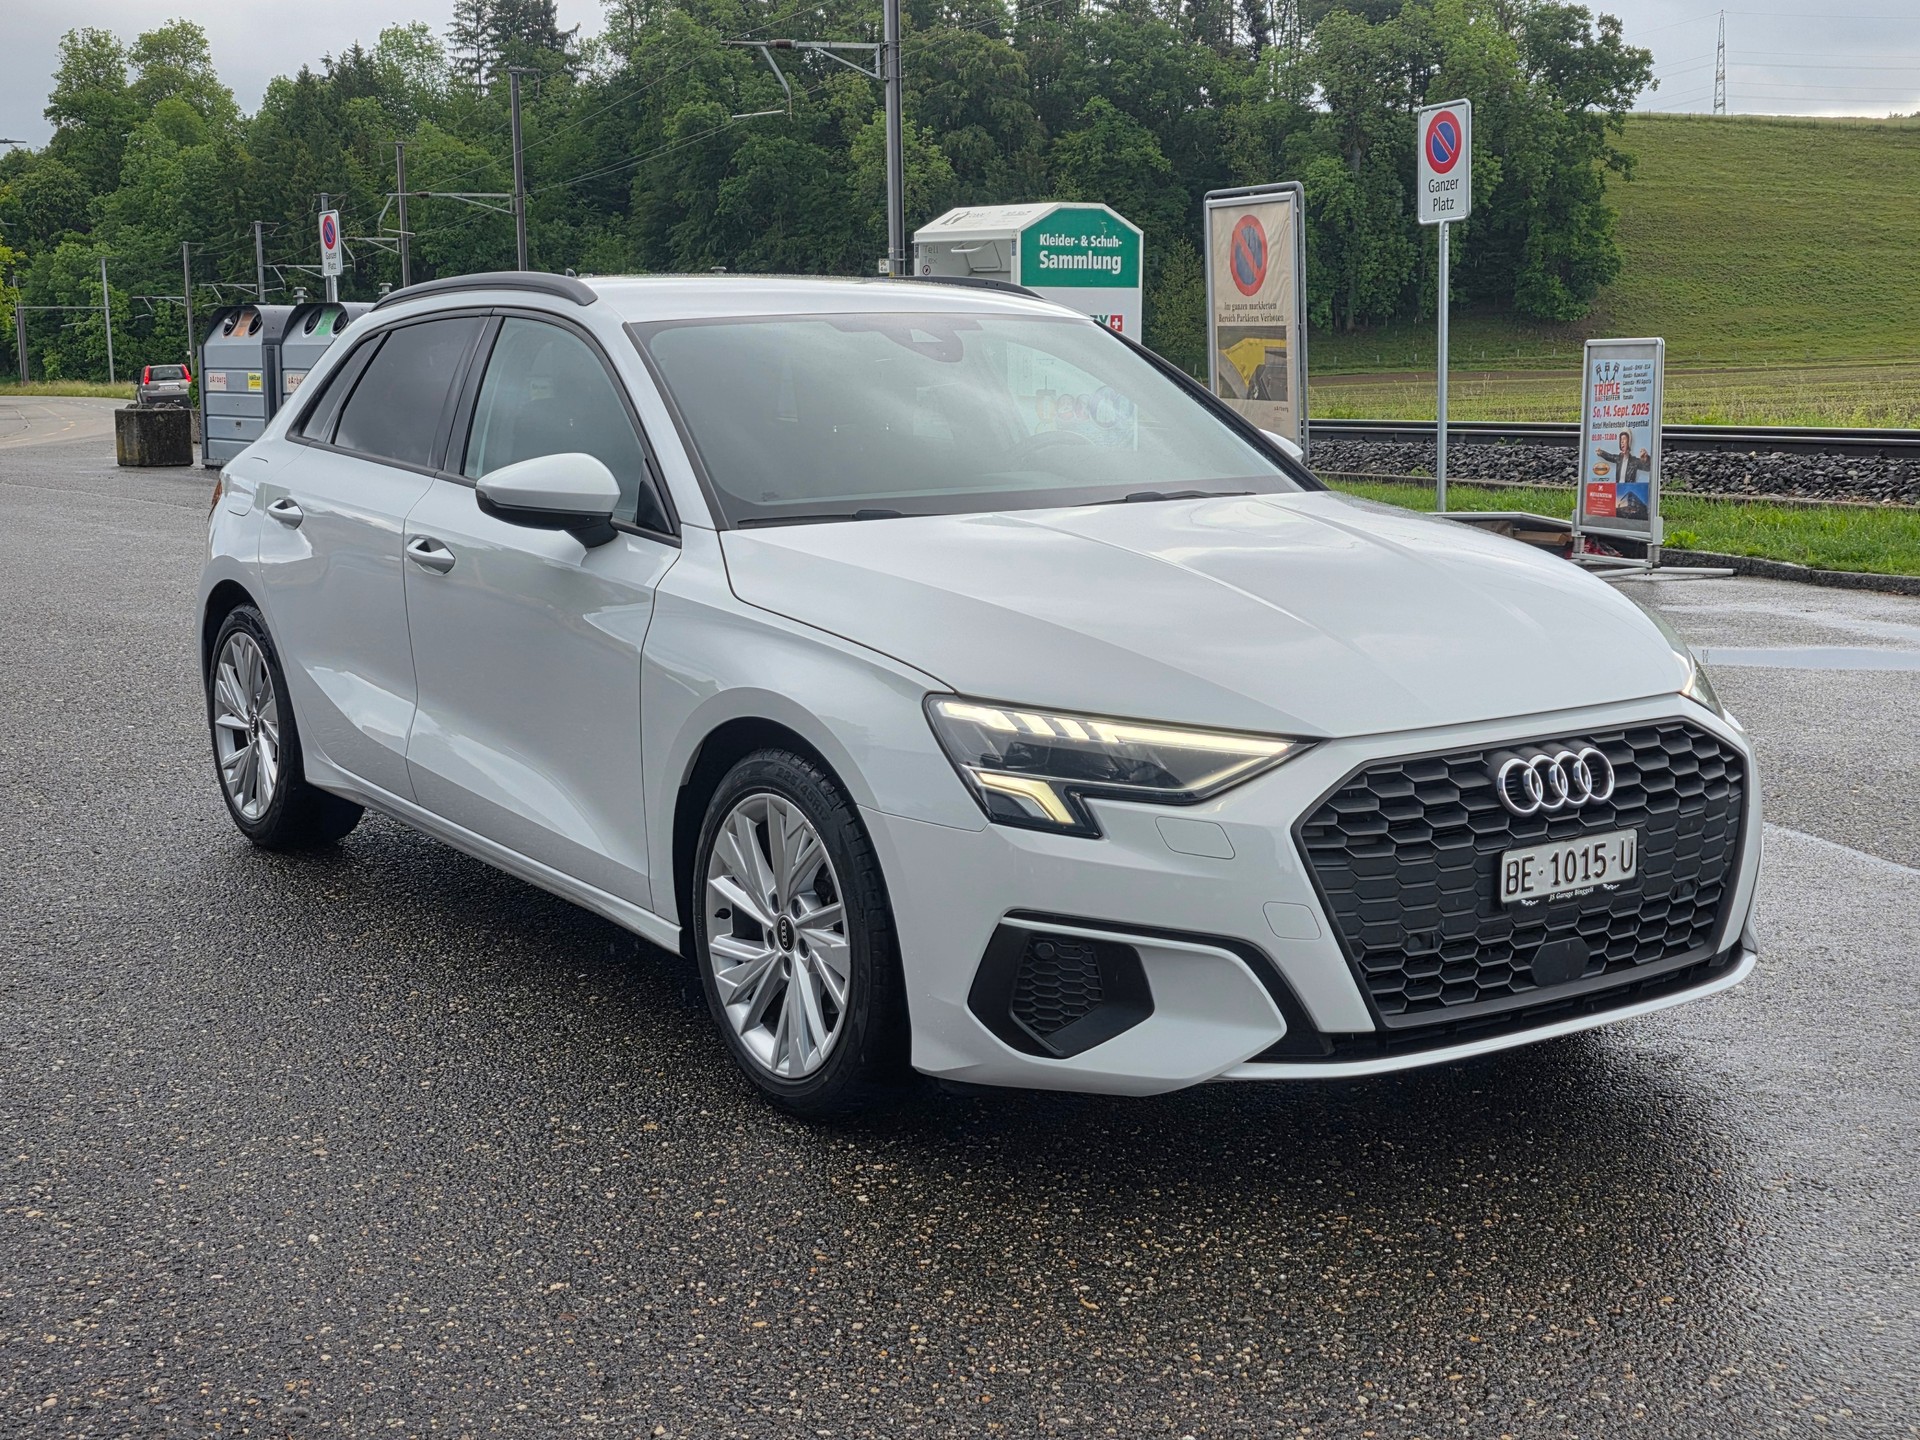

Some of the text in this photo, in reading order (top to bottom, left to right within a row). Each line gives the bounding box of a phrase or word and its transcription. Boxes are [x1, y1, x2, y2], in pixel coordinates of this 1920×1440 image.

[1428, 178, 1459, 193] Ganzer
[1432, 197, 1454, 212] Platz
[1040, 233, 1123, 247] Kleider- & Schuh-
[923, 244, 939, 254] Tell
[1039, 250, 1122, 275] Sammlung
[1594, 383, 1620, 396] TRIPLE
[1603, 405, 1612, 417] 14.
[1613, 404, 1630, 418] Sept.
[1631, 402, 1650, 416] 2025
[1556, 890, 1574, 899] Garage
